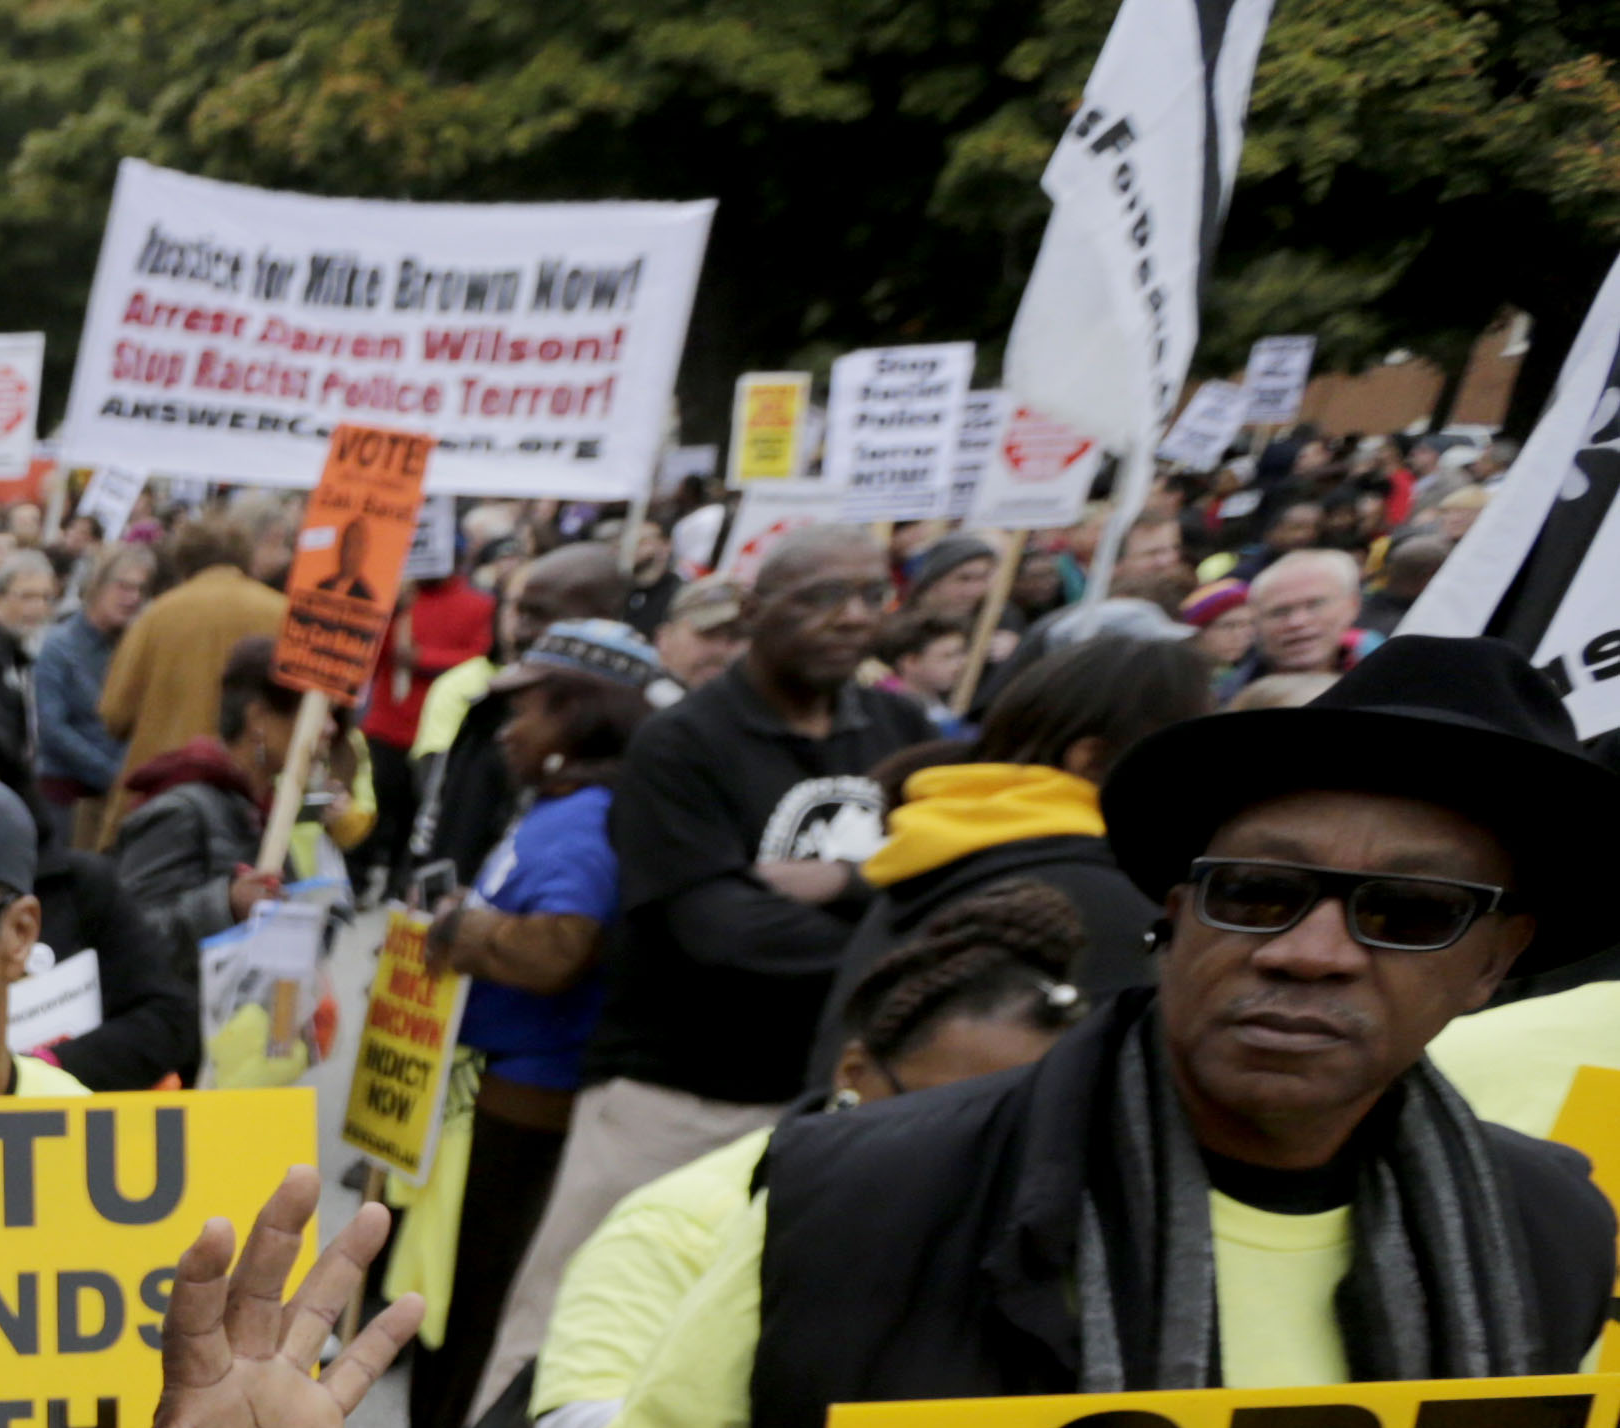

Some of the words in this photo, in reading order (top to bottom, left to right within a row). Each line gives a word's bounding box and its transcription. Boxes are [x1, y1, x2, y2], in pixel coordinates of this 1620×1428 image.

[135, 225, 243, 290] Justice
[252, 247, 296, 300] for
[304, 254, 383, 308] Mike
[394, 256, 520, 311] Brown
[533, 254, 643, 311] Now!
[123, 291, 248, 338] Arrest
[259, 317, 405, 360] Darren
[423, 326, 625, 362] Wilson!
[111, 340, 186, 388] Stop
[193, 346, 312, 400] Racist
[320, 370, 443, 414] Police
[461, 374, 618, 416] Terror!
[364, 1039, 433, 1092] INDICT
[368, 1081, 416, 1125] NOW
